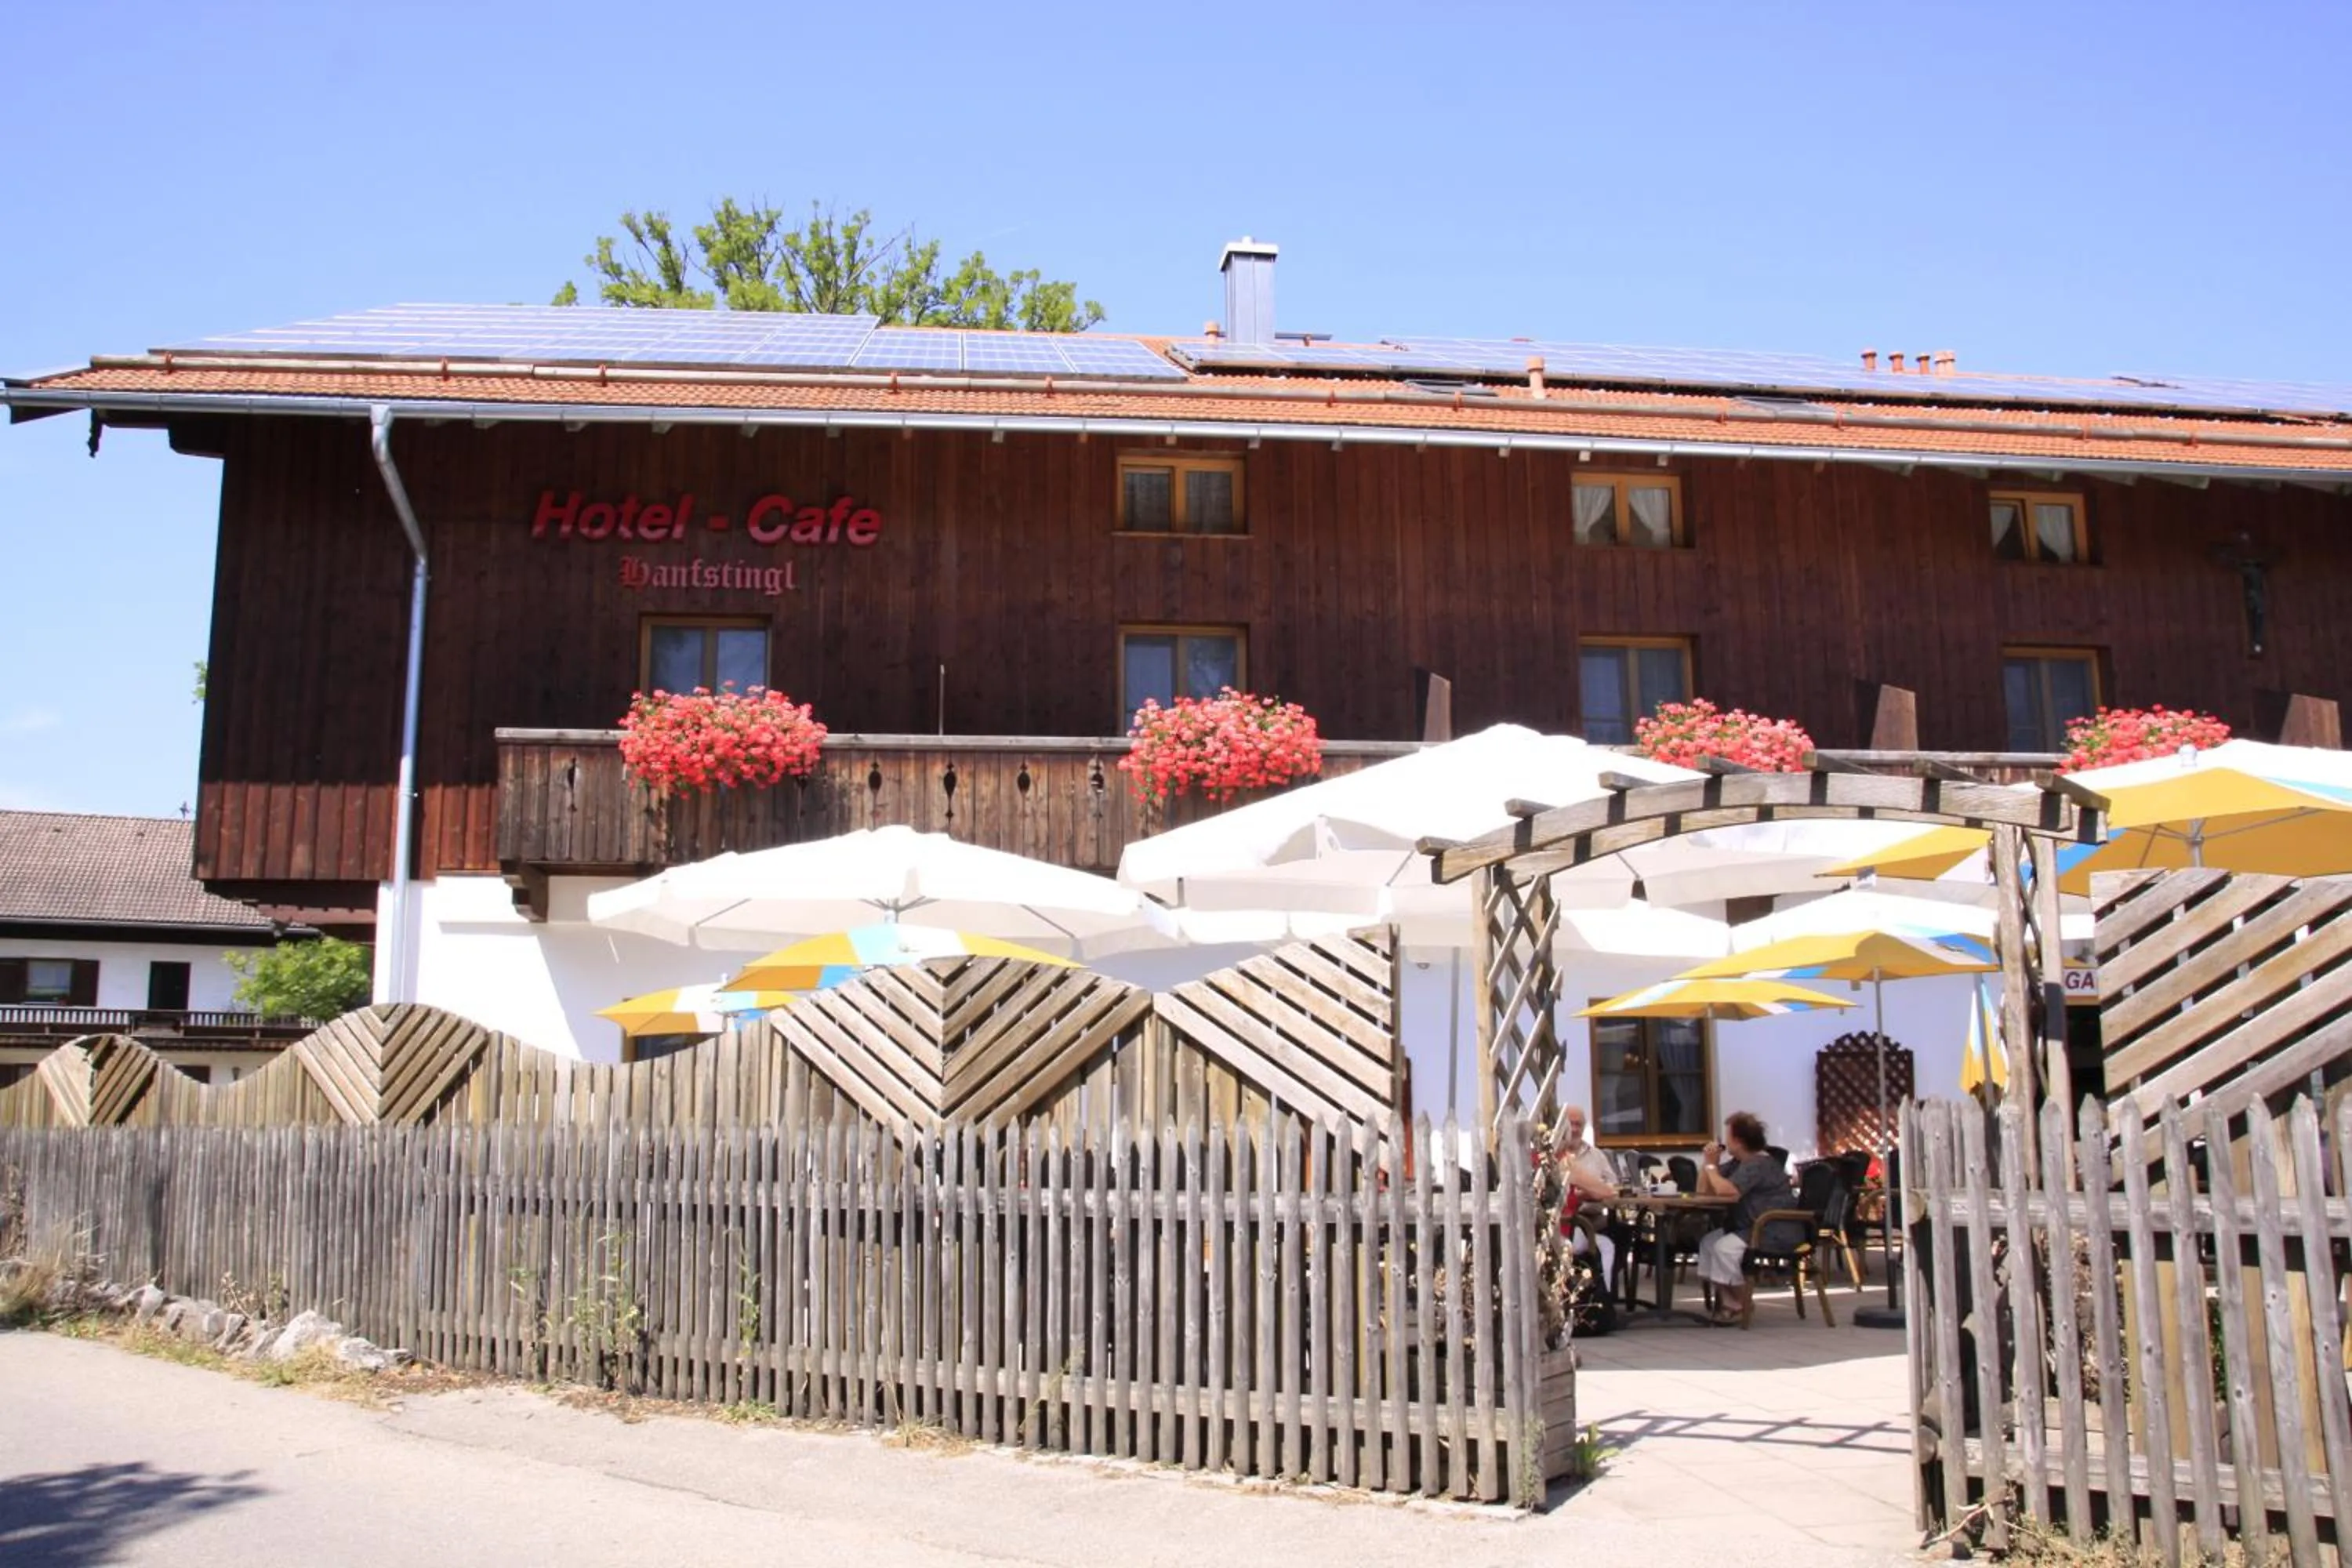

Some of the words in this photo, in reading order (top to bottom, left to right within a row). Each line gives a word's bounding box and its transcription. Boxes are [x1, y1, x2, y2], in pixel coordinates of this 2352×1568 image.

[532, 491, 694, 540] Hotel
[747, 495, 881, 544] Cafe
[620, 556, 797, 596] Hanfstingl
[2065, 971, 2095, 989] GA
